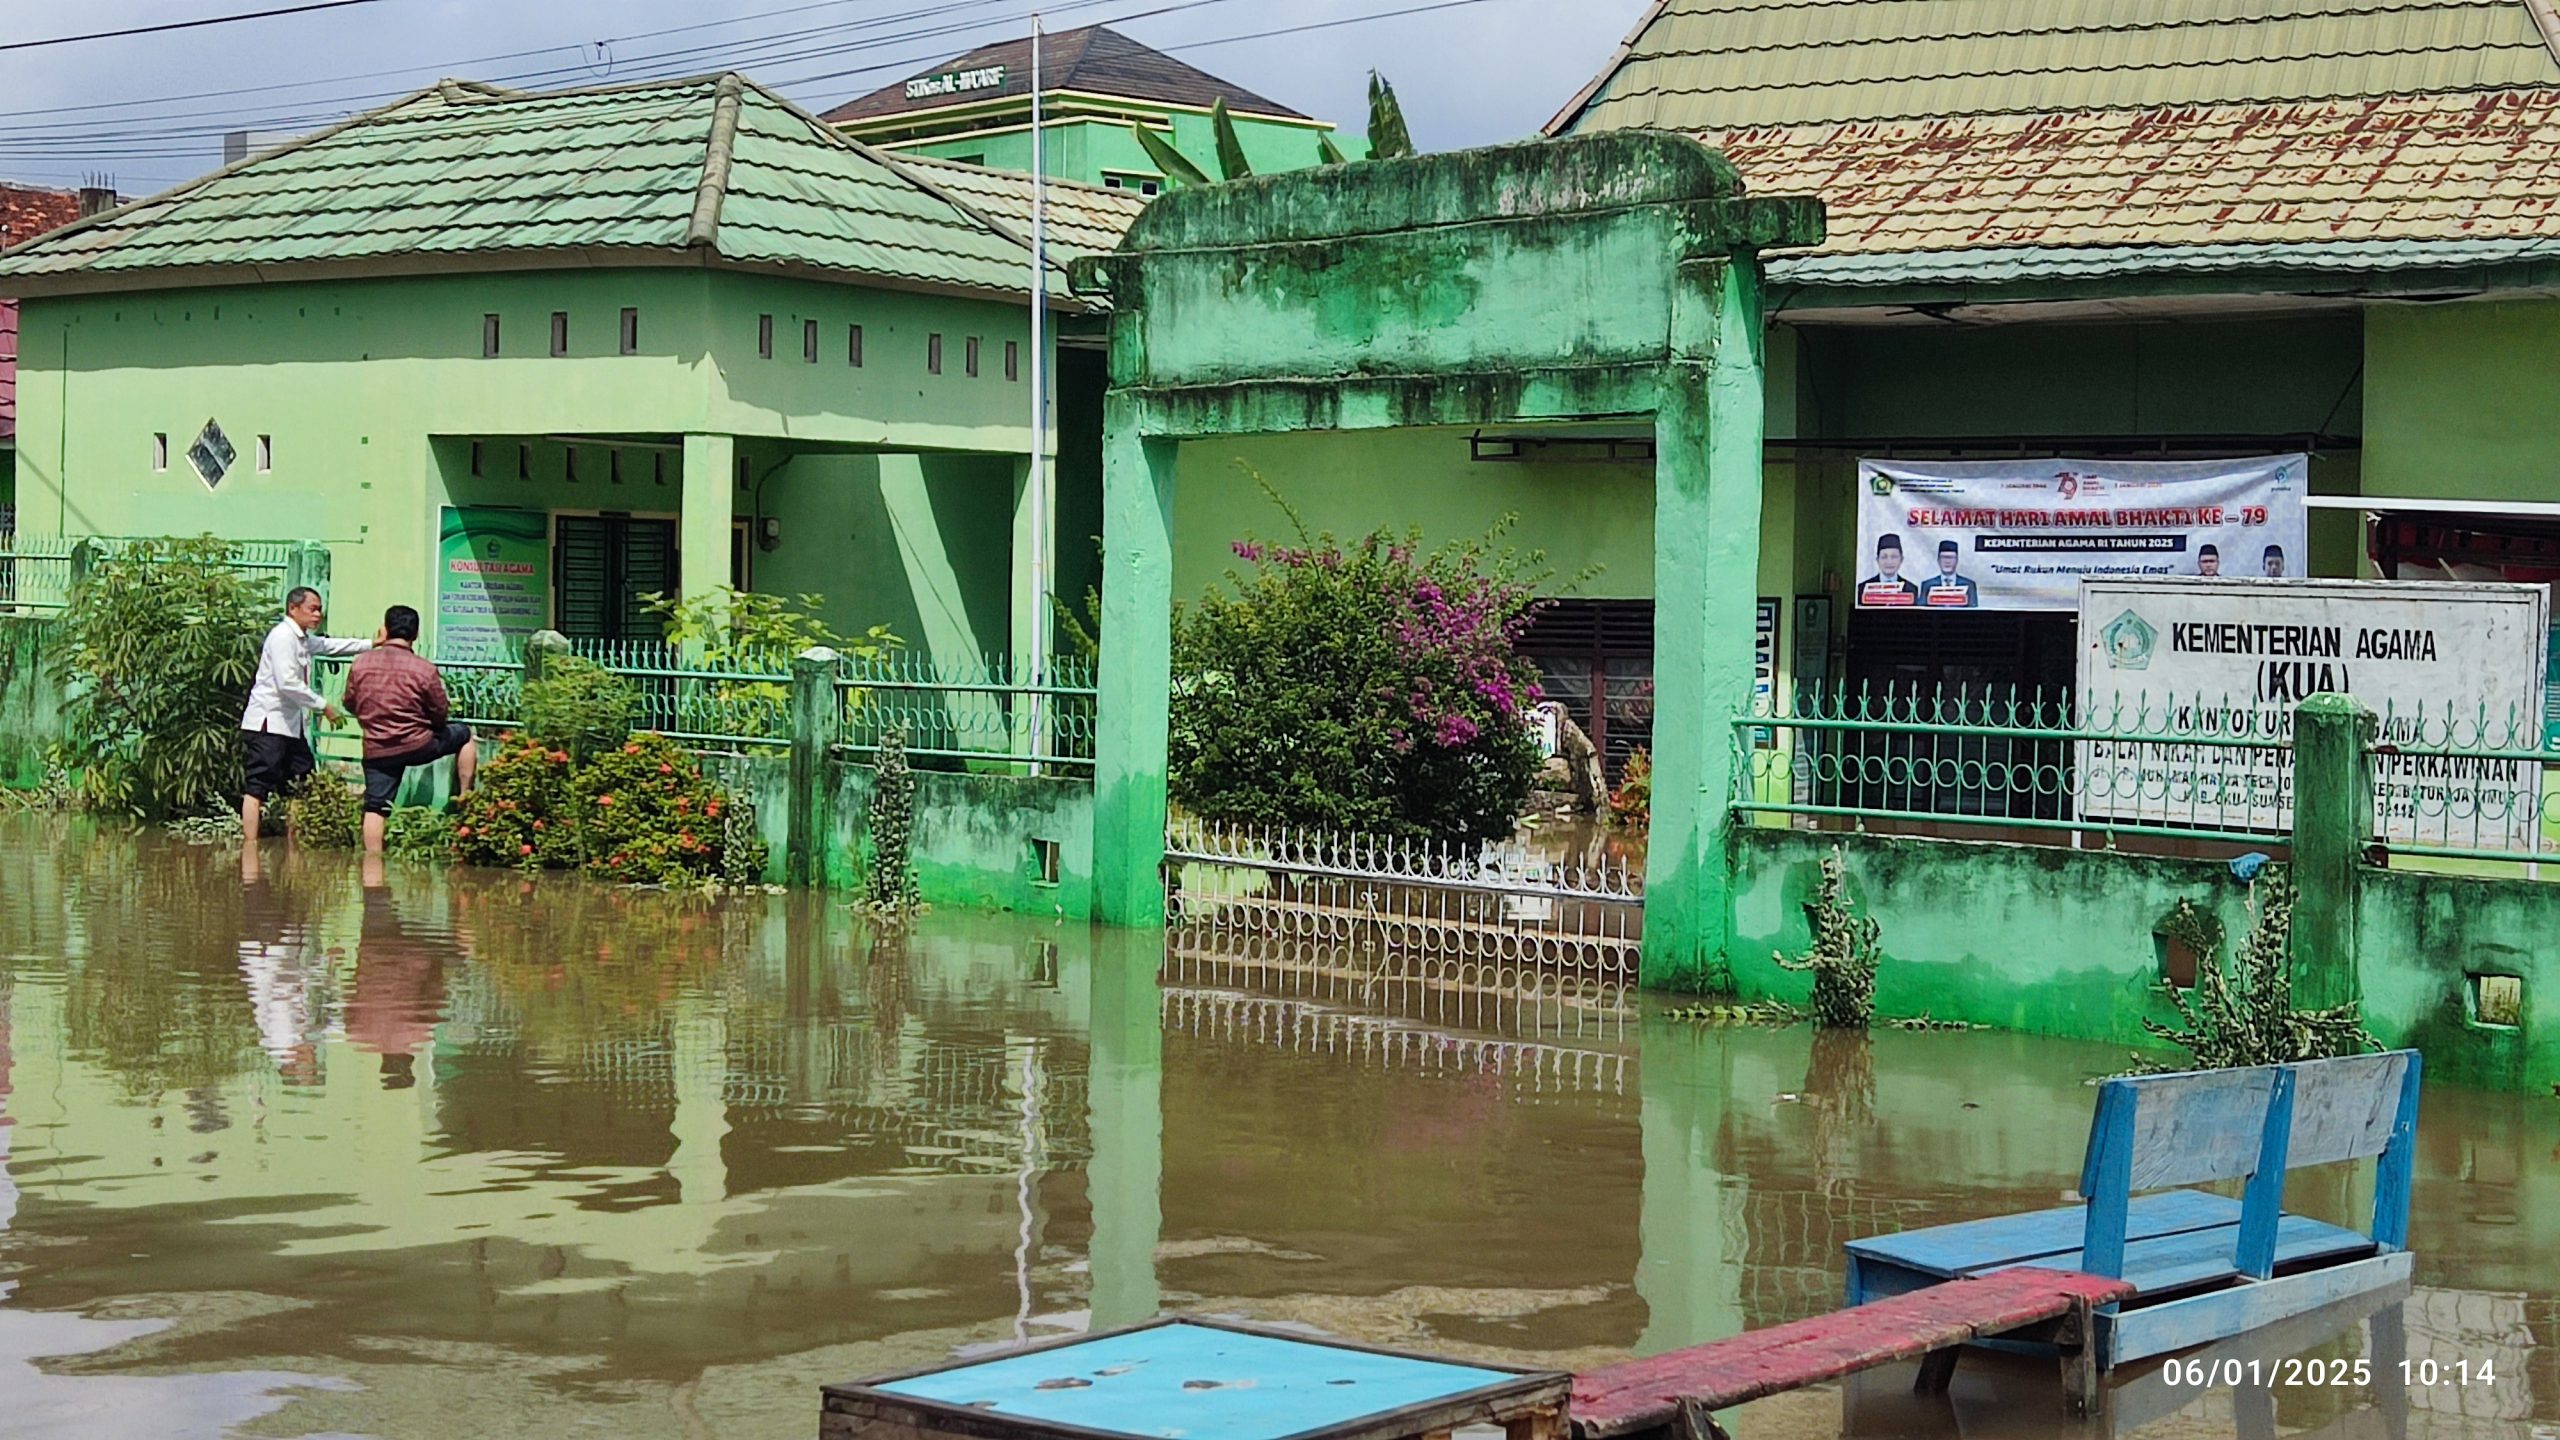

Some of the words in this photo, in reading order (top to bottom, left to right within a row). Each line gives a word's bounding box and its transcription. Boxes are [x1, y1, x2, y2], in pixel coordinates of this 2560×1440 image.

[1908, 509, 1997, 528] SELAMAT
[2000, 508, 2050, 528] HARI
[2053, 508, 2112, 528] AMAL
[2115, 508, 2195, 528] BHAKTI
[2197, 506, 2223, 526] KE
[2242, 505, 2269, 526] 79
[1984, 538, 2057, 548] KEMENTERIAN
[2058, 538, 2096, 548] AGAMA
[2097, 538, 2108, 548] RI
[2110, 538, 2147, 549] TAHUN
[2148, 539, 2174, 548] 2025
[2024, 565, 2054, 574] Rukun
[2056, 565, 2093, 575] Menuju
[2094, 565, 2140, 574] Indonesia
[2172, 622, 2341, 657] KEMENTERIAN
[2356, 628, 2437, 661] AGAMA
[2258, 660, 2349, 703] (KUA)
[2403, 785, 2469, 803] BTURJA
